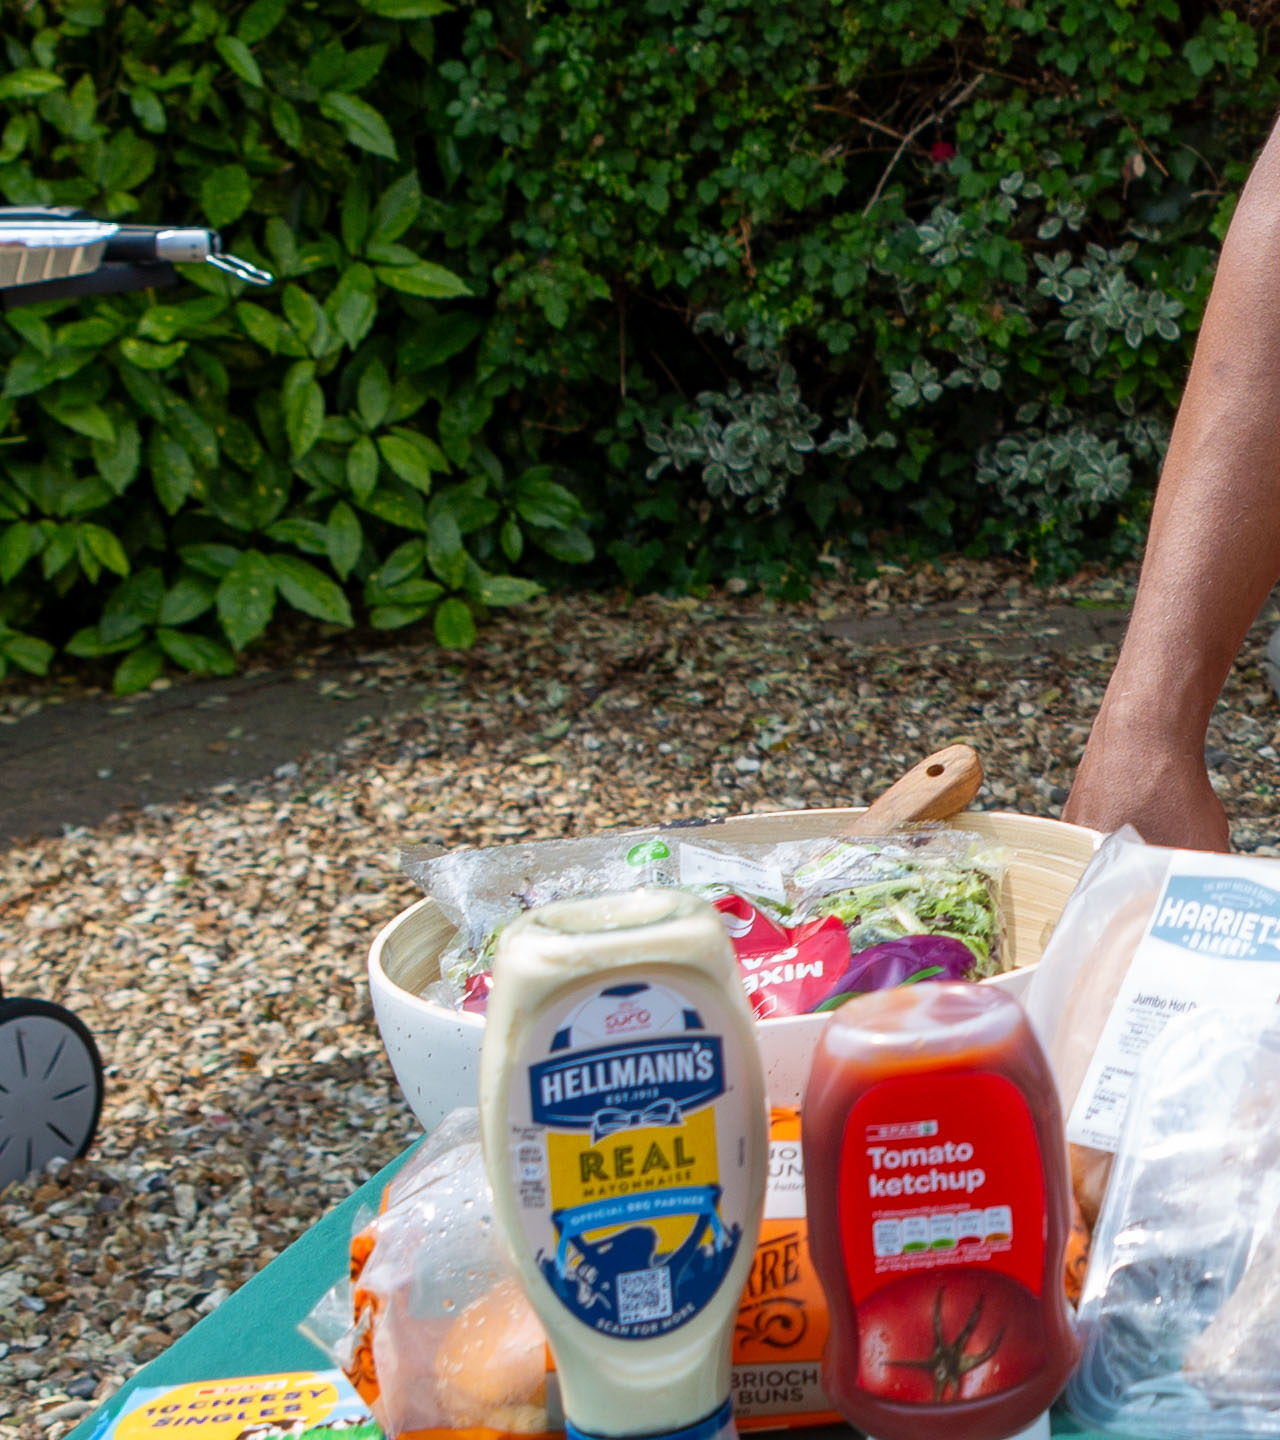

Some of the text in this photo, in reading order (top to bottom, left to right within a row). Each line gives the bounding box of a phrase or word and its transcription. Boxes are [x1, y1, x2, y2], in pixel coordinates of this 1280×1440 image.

[742, 960, 823, 995] MIXE
[1132, 992, 1168, 1010] Jumbo
[540, 1041, 715, 1107] HELLMANN'S
[579, 1136, 696, 1183] REAL
[866, 1140, 974, 1171] Tomato
[583, 1171, 692, 1197] MAYONNAISE
[868, 1168, 986, 1199] ketchup
[570, 1195, 704, 1226] OFFICIAL BBQ PARTNER
[597, 1302, 696, 1336] SCAN FOR MORE
[731, 1368, 818, 1389] BRIOCH
[146, 1388, 329, 1416] 10 CHEESY
[739, 1387, 804, 1404] BUNS
[151, 1403, 303, 1427] SINGLES
